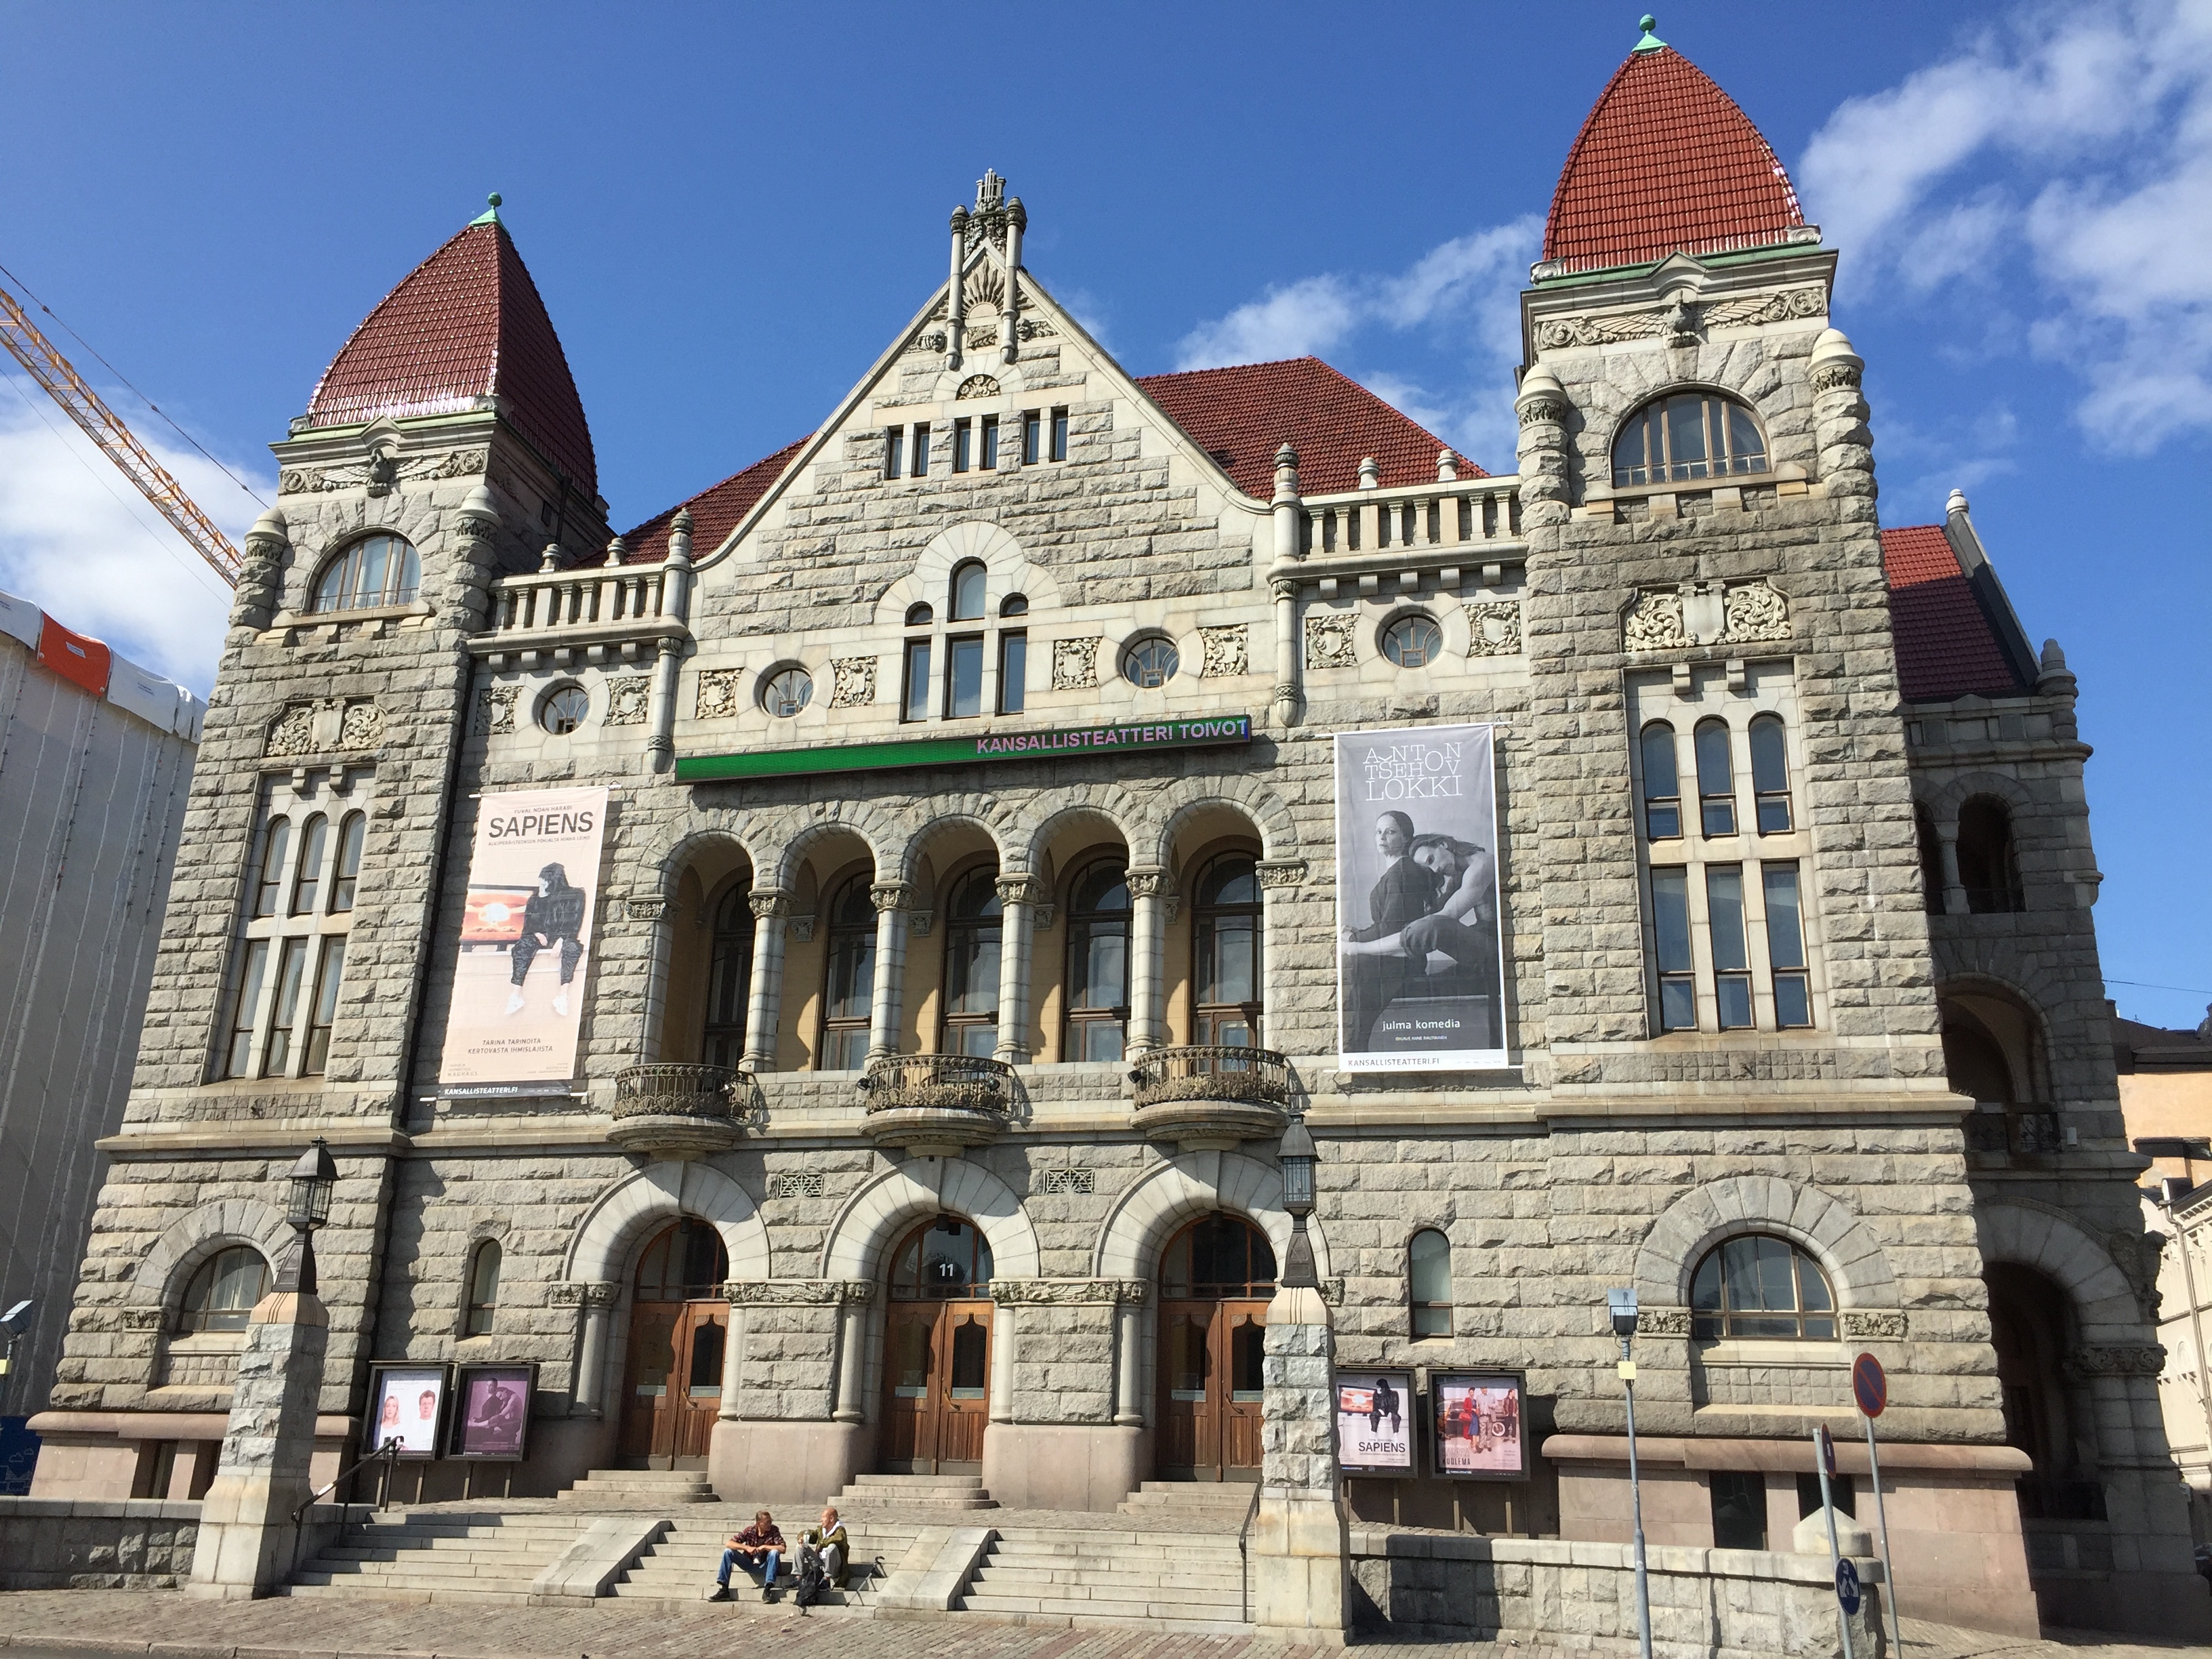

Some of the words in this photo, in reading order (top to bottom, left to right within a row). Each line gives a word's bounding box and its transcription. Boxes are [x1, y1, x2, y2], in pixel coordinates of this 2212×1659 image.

[977, 725, 1172, 754] KANSALLISTEATTERI
[1179, 719, 1247, 739] TOIVOT
[1363, 742, 1462, 771] ANTON
[1366, 775, 1462, 801] LOKKI
[489, 811, 594, 838] SAPIENS
[1382, 1021, 1412, 1031] julma
[1416, 1019, 1460, 1029] komedia
[1348, 1058, 1439, 1067] KANSALLISTEATTERI.FI
[445, 1086, 518, 1095] KANSALLISTEATTERI.FI
[939, 1263, 954, 1277] 11
[1358, 1441, 1406, 1452] SAPIENS
